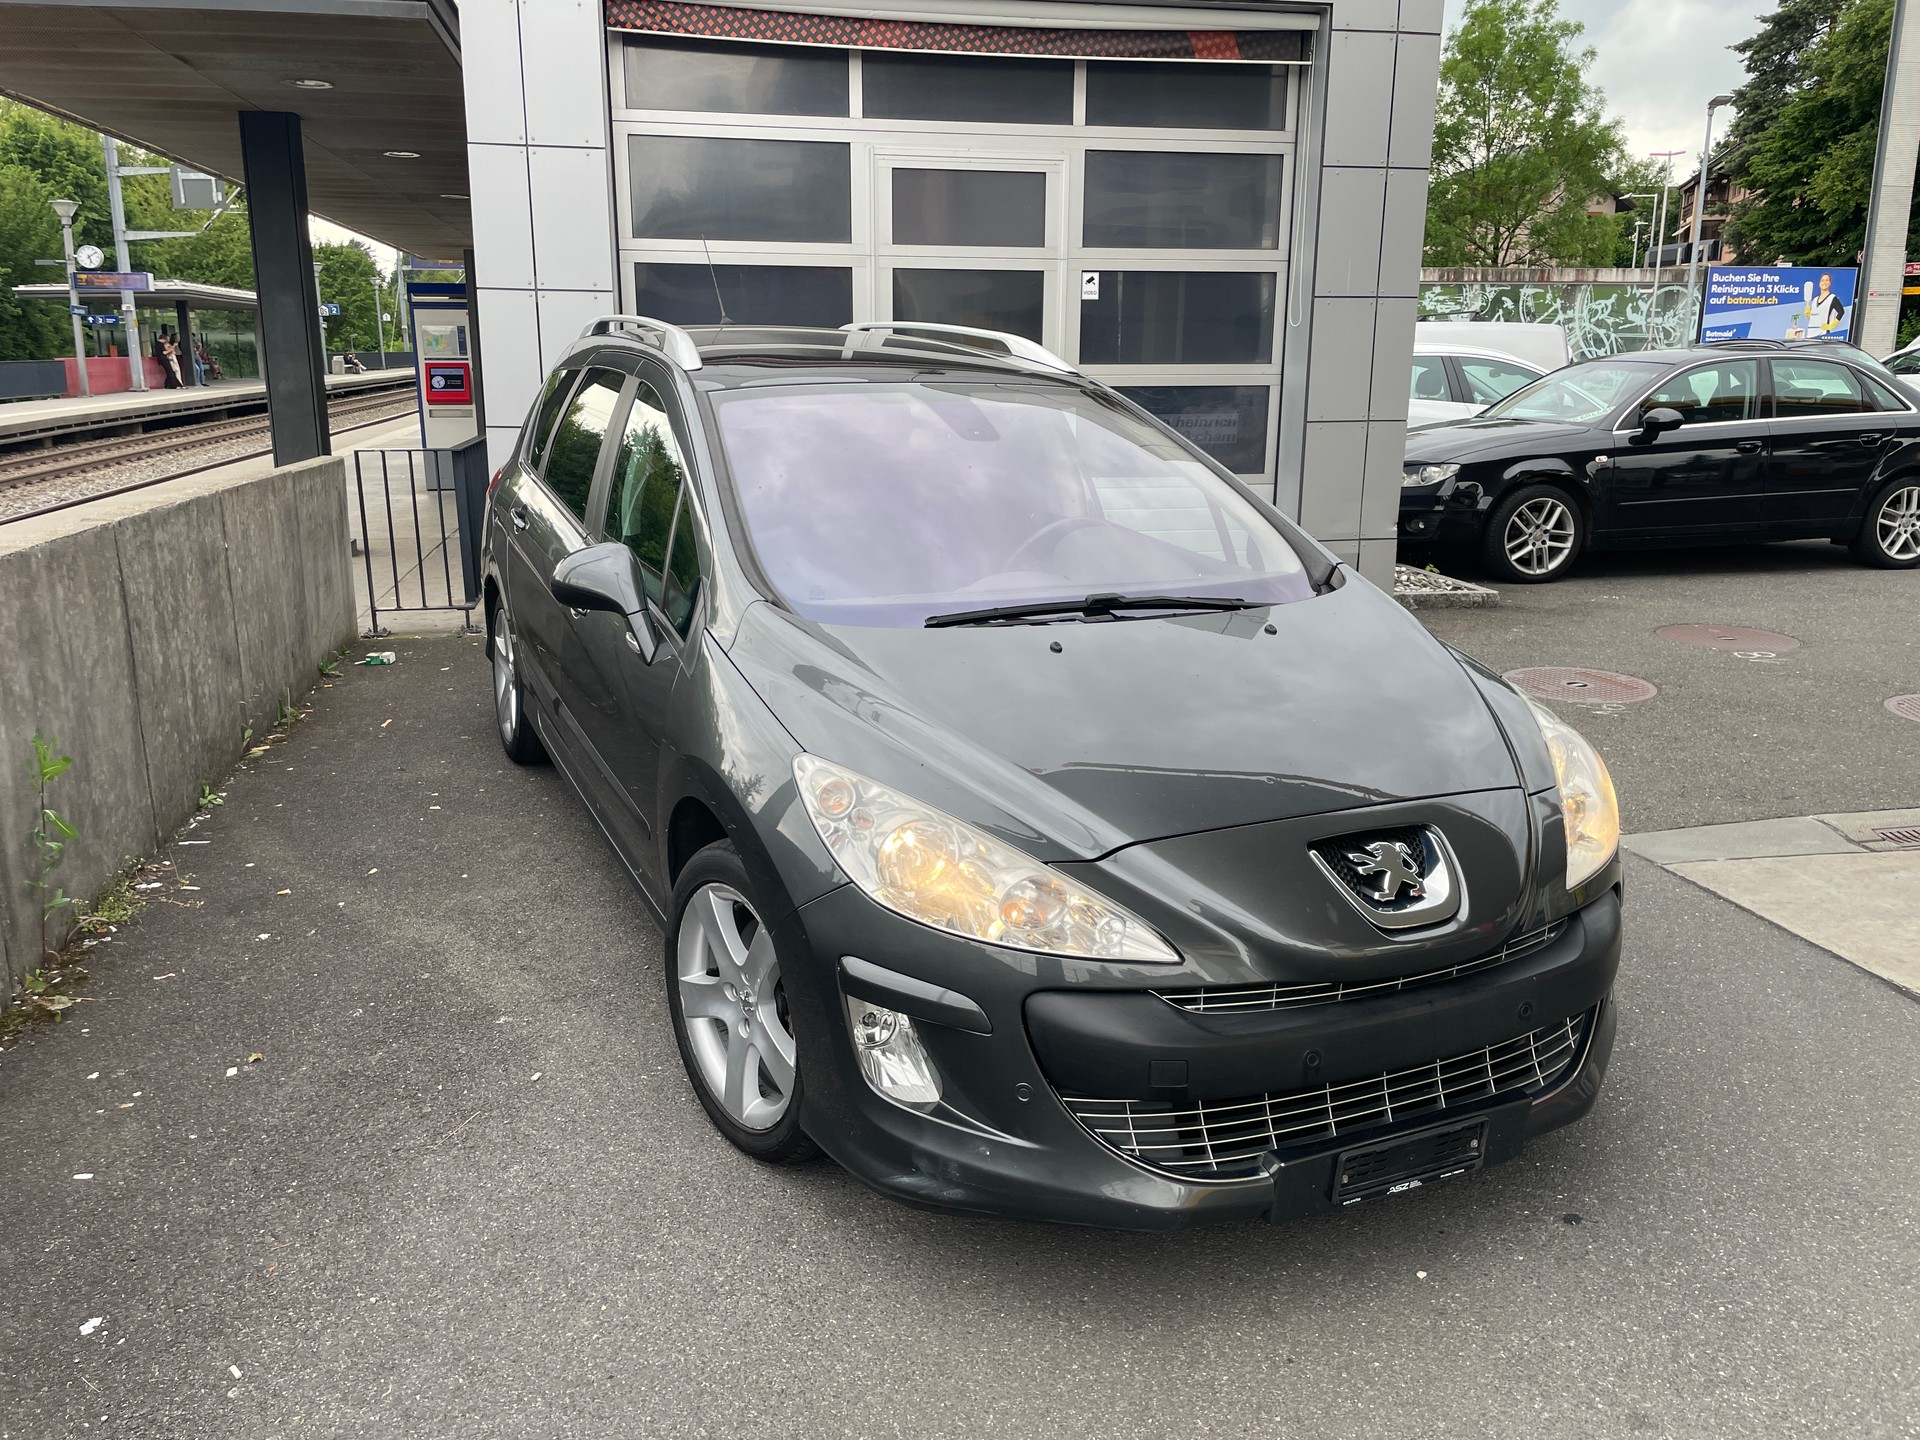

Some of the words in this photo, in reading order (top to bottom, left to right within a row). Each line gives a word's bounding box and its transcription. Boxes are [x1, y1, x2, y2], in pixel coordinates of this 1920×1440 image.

[1712, 273, 1746, 282] Buchen
[1747, 273, 1762, 283] Sie
[1762, 273, 1780, 283] Ihre
[1711, 284, 1755, 295] Reinigung
[1756, 284, 1765, 294] in
[1766, 284, 1773, 294] 3
[1773, 285, 1800, 294] Klicks
[1709, 295, 1727, 305] auf
[1727, 296, 1779, 305] batmaid.ch
[1705, 330, 1733, 338] Batmaid
[1175, 415, 1237, 428] heinrich
